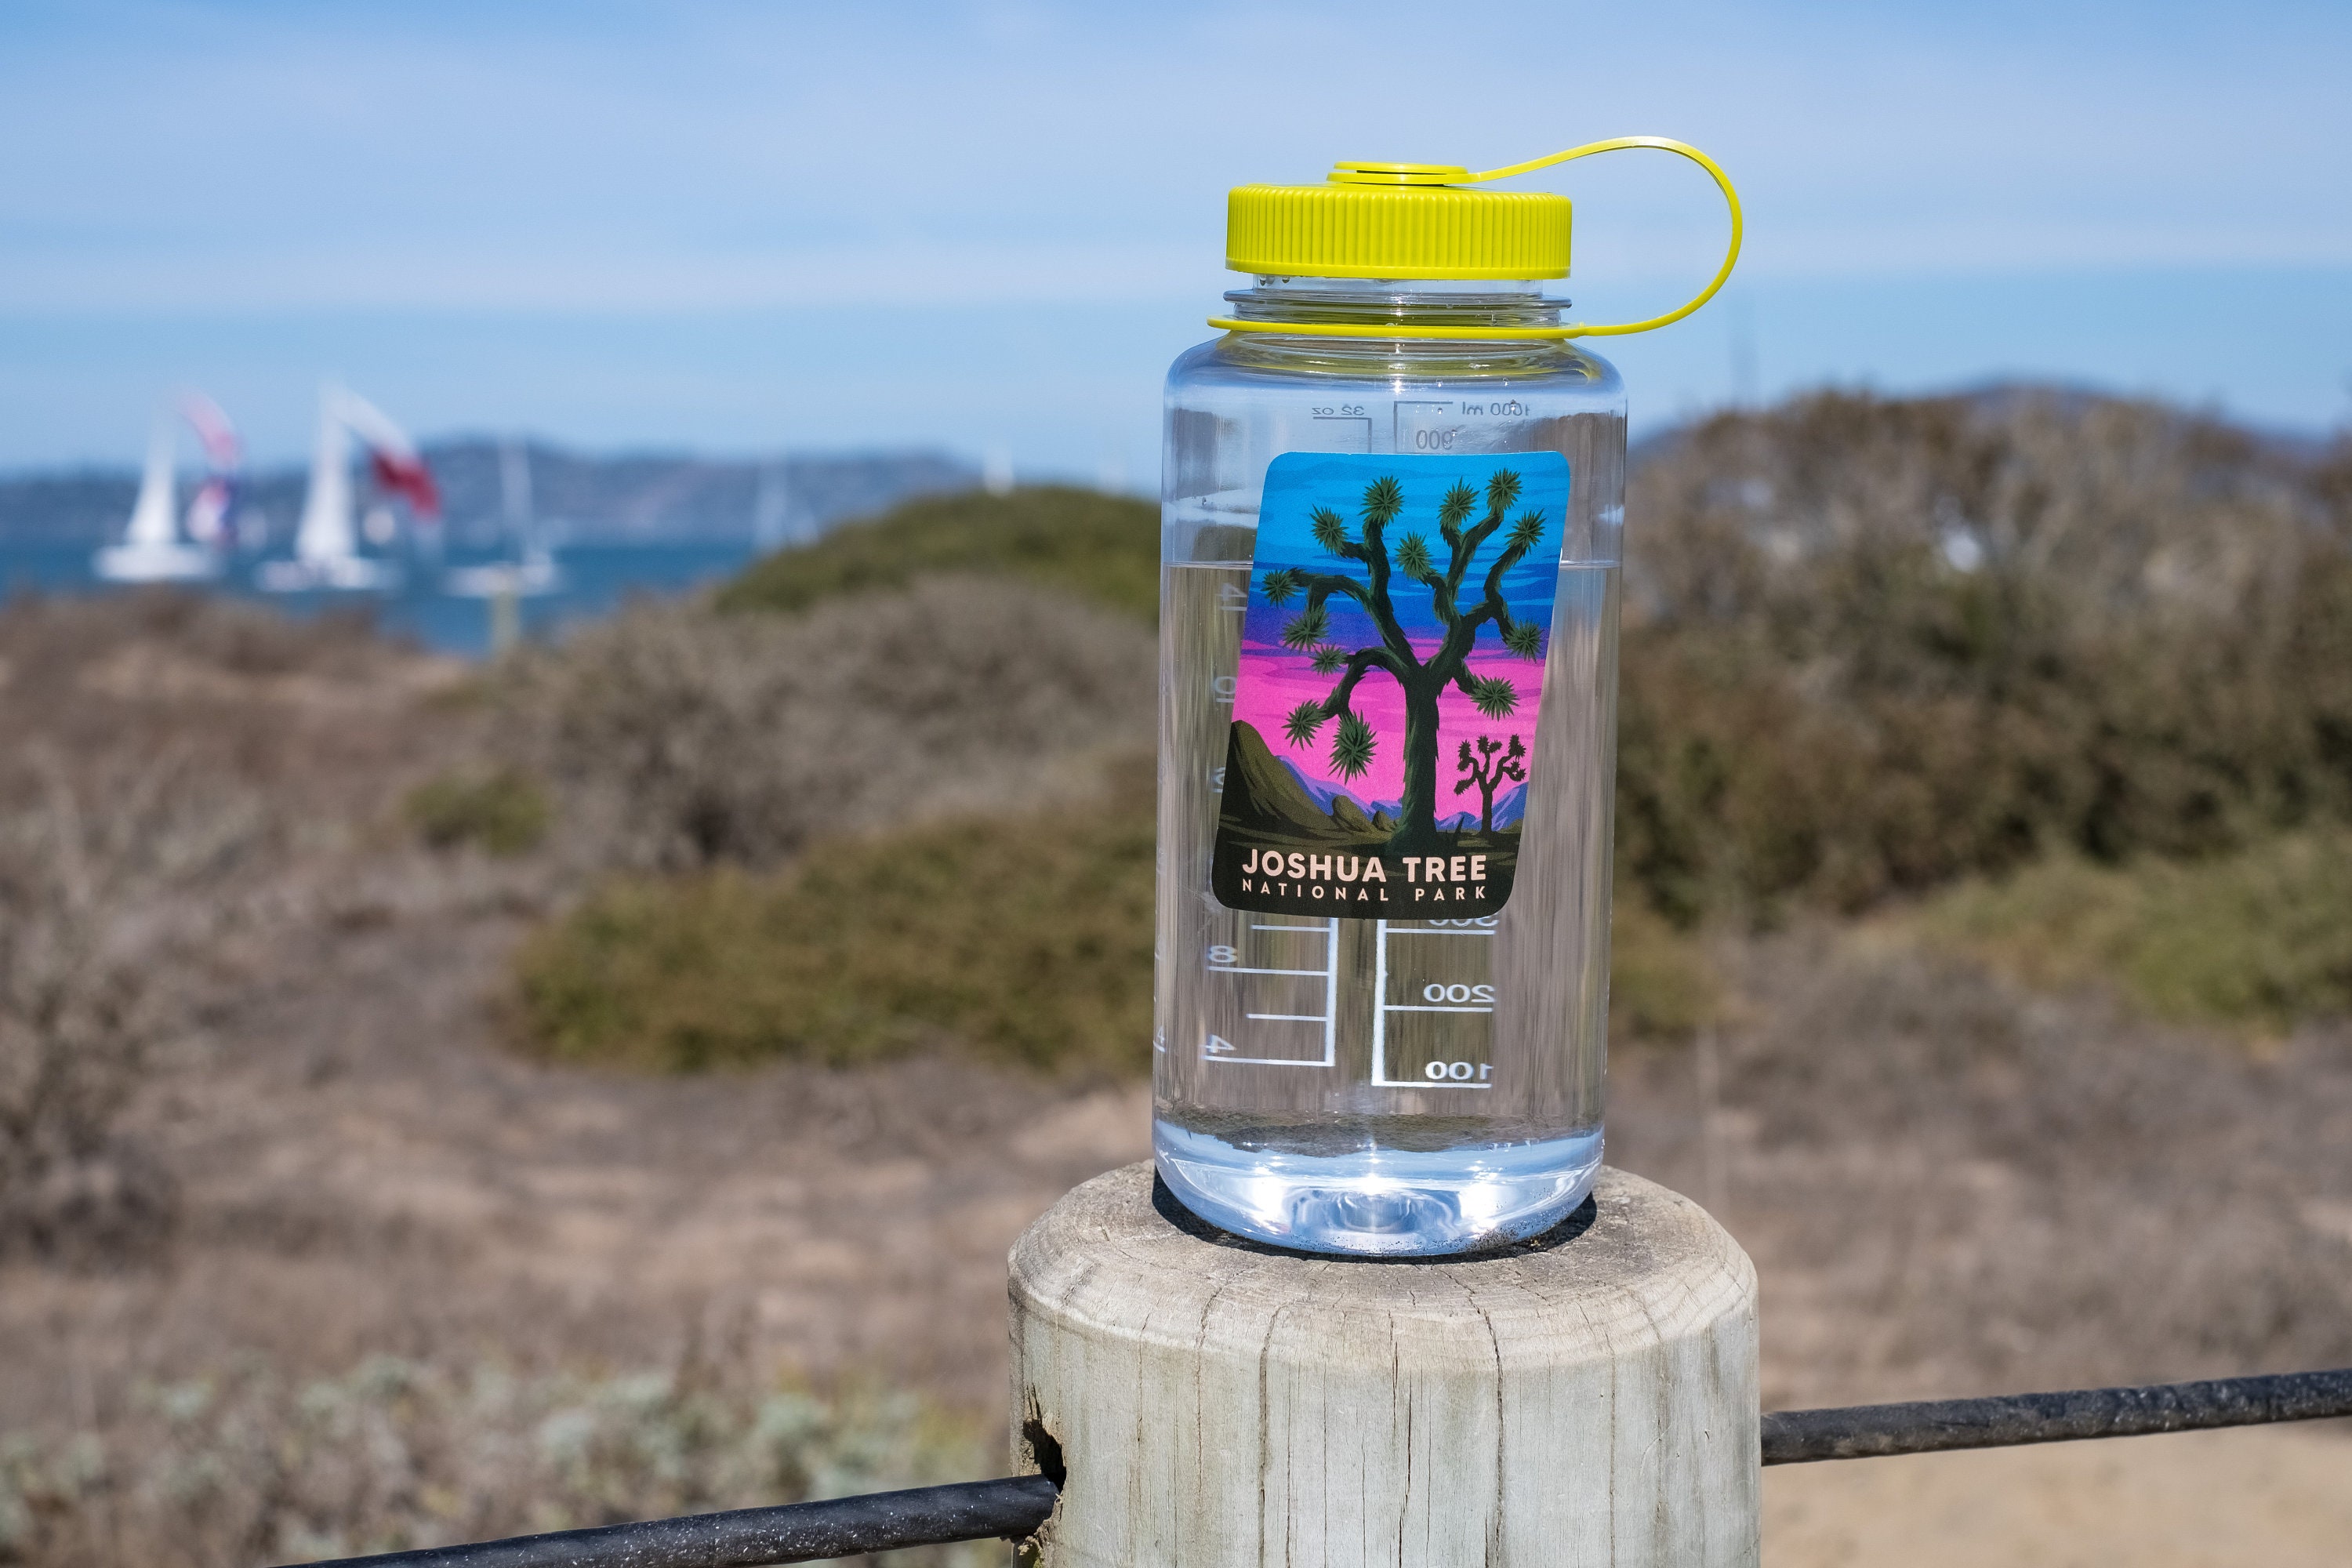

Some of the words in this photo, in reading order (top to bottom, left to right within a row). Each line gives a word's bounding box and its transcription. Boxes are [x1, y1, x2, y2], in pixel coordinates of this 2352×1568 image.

[1242, 848, 1387, 883] JOSHUA
[1402, 855, 1487, 882] TREE
[1242, 878, 1389, 902] NATIONAL
[1414, 885, 1486, 902] PARK
